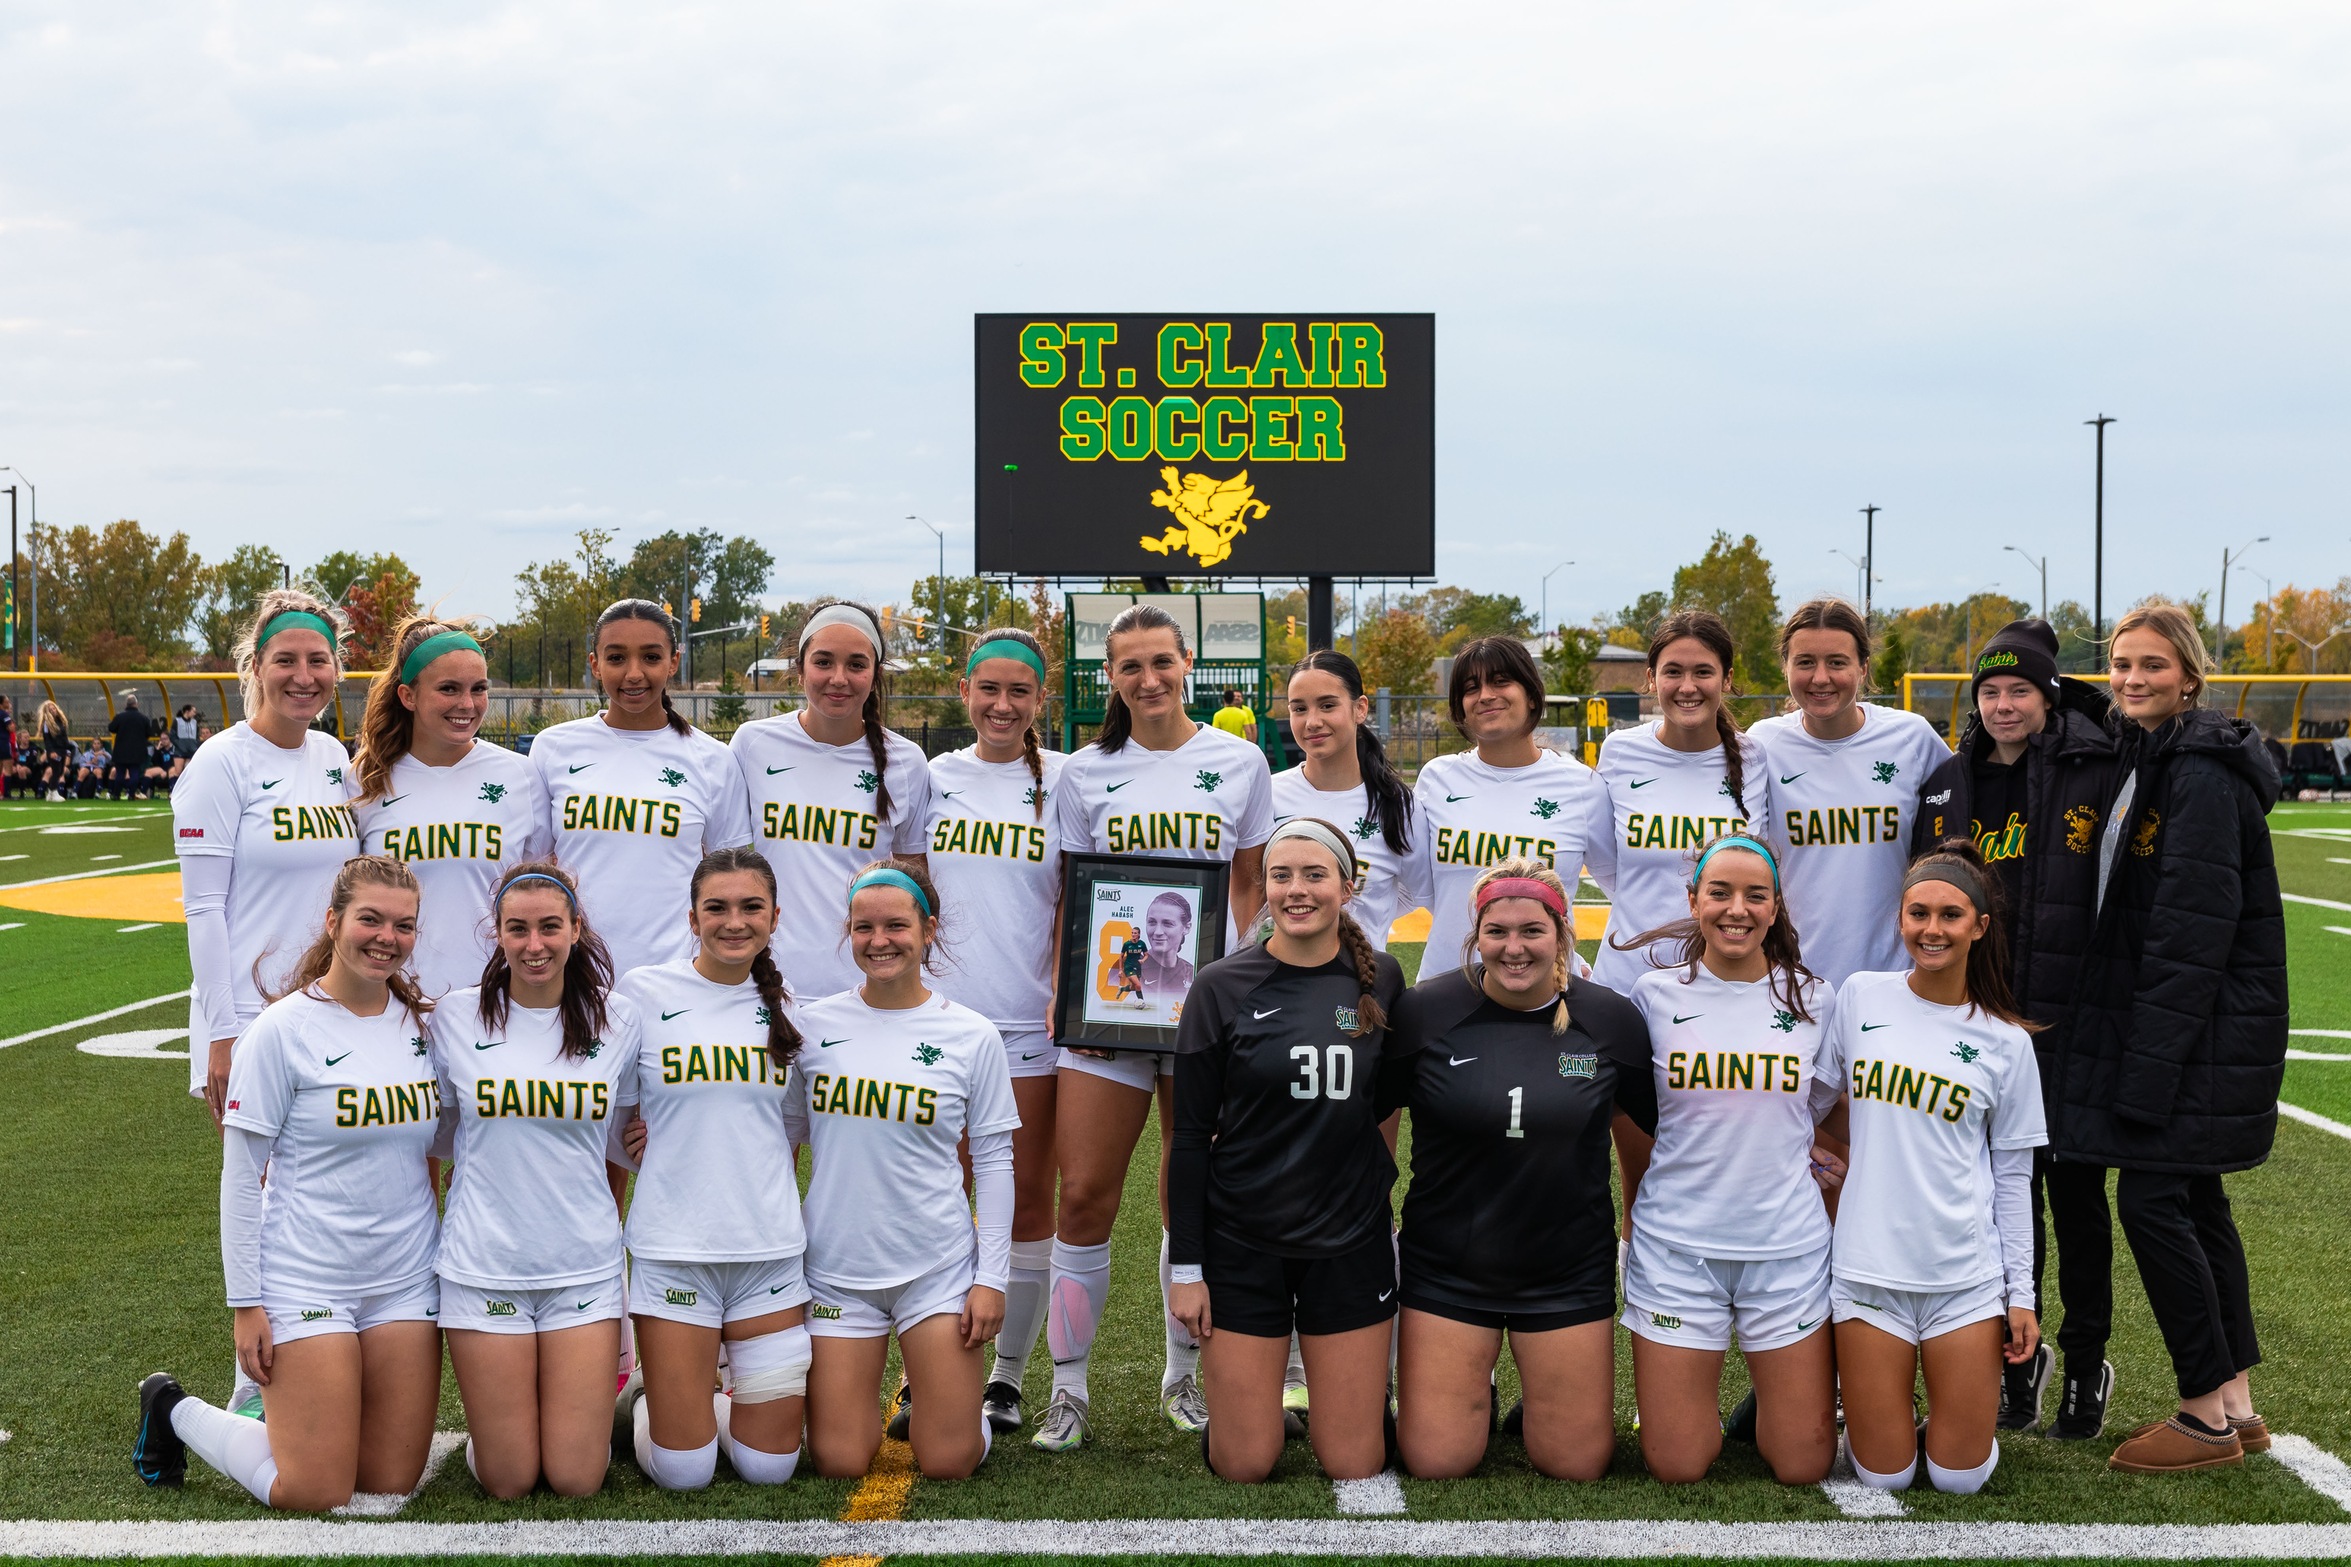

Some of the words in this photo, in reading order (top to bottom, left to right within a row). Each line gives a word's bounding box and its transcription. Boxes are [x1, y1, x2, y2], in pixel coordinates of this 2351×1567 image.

[1019, 322, 1136, 388] ST.
[1157, 322, 1387, 388] CLAIR
[1059, 396, 1346, 461] SOCCER
[273, 805, 357, 841] SAINT
[563, 794, 681, 838] SAINTS
[763, 801, 880, 850] SAINTS
[1108, 811, 1222, 853] SAINTS
[1787, 806, 1899, 847] SAINTS
[384, 822, 502, 863] SAINTS
[933, 819, 1045, 863] SAINTS
[1097, 889, 1121, 902] SAINTS
[1336, 1009, 1360, 1026] SAIN
[1290, 1045, 1353, 1100] 30
[1559, 1056, 1598, 1077] SAINTS
[1668, 1052, 1800, 1093] SAINTS
[476, 1079, 608, 1121] SAINTS
[812, 1074, 937, 1126] SAINTS
[1852, 1059, 1970, 1123] SAINTS
[1506, 1087, 1524, 1138] 1
[665, 1288, 698, 1306] SAINTS
